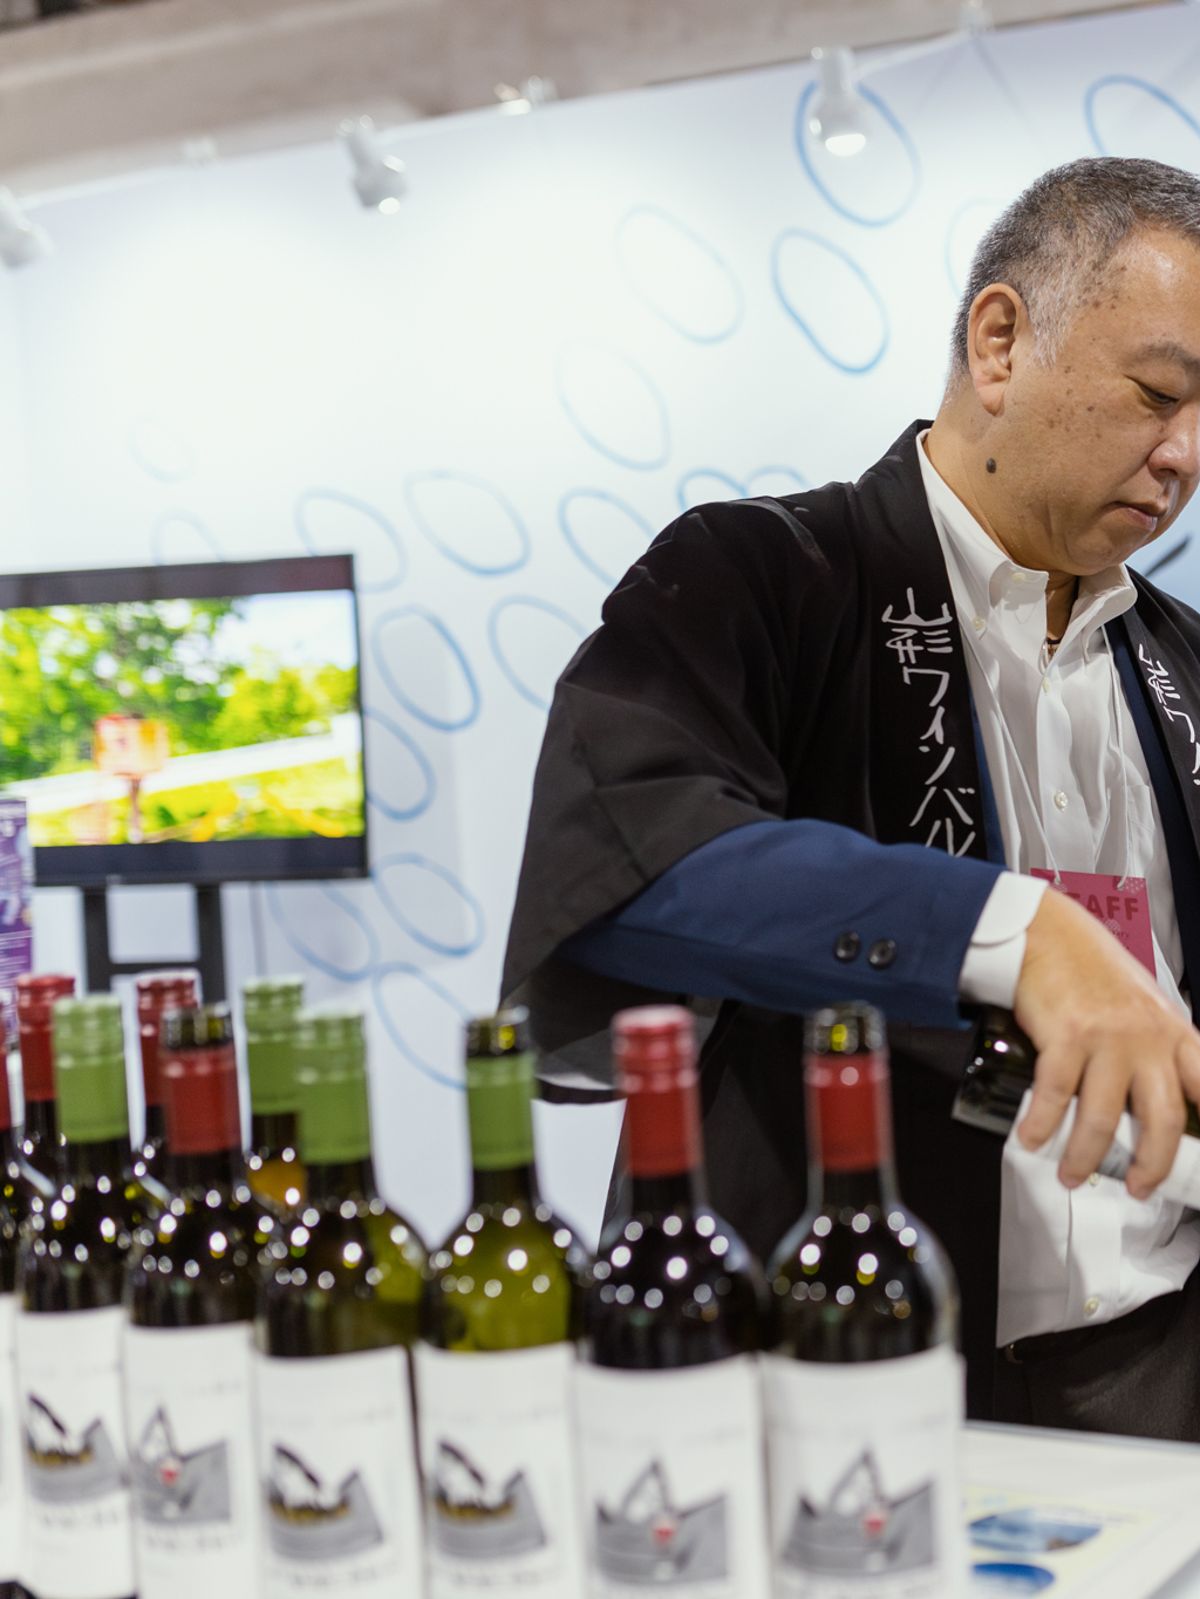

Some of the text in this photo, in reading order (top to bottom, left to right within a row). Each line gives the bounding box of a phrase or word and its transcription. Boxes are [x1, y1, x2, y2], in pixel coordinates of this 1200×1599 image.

[881, 586, 977, 858] 山形ワインバル
[1064, 891, 1139, 921] AFF
